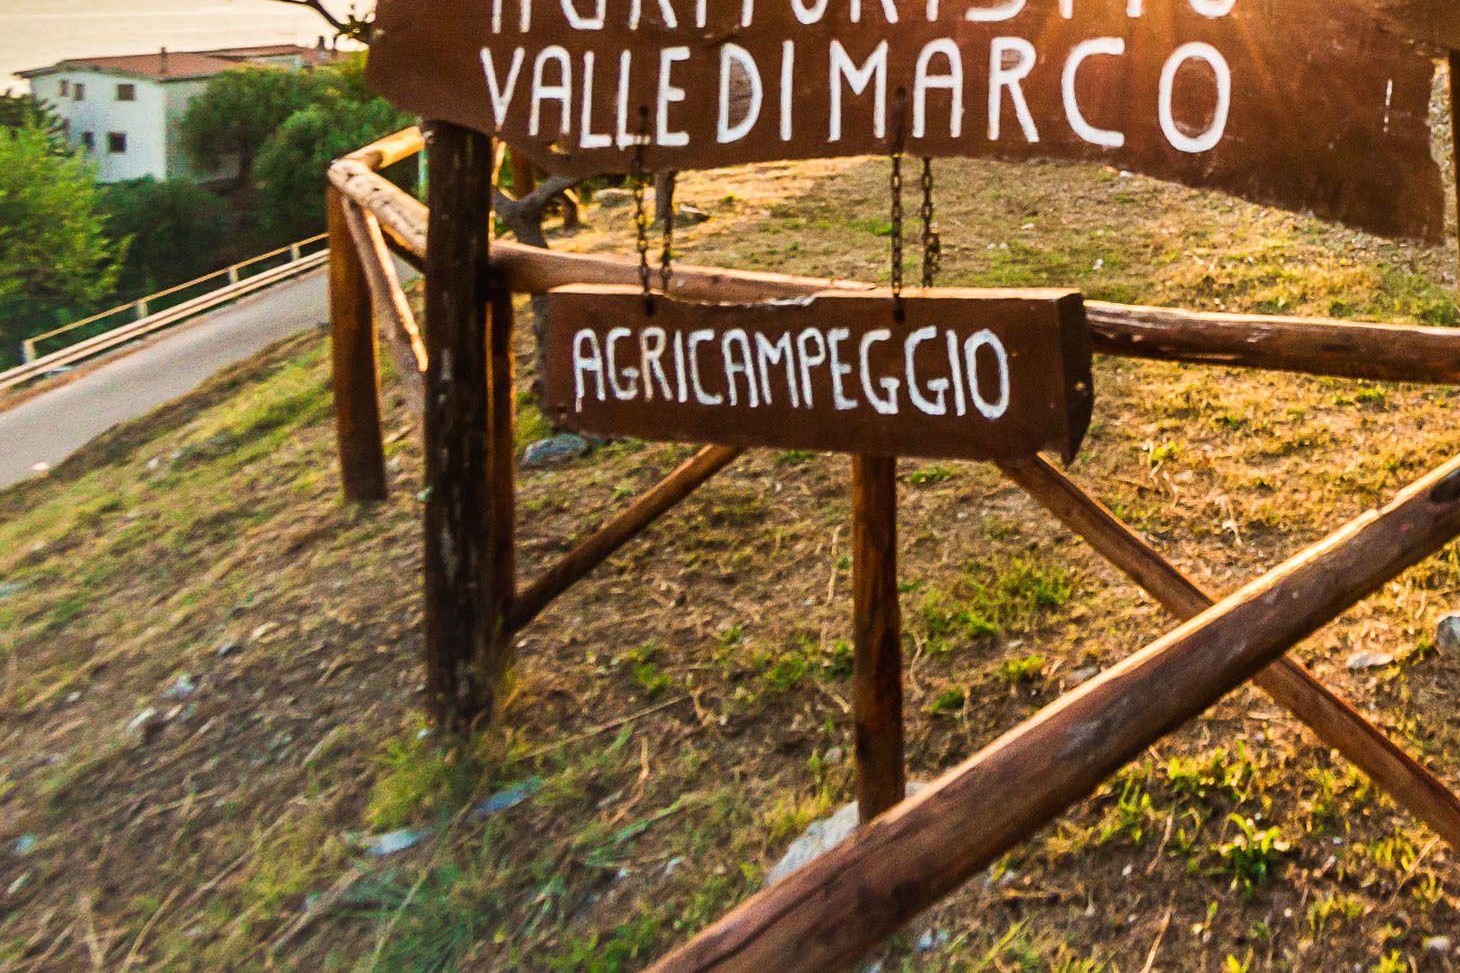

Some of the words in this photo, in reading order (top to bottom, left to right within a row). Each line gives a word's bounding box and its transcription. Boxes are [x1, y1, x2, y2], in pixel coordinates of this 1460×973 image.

[480, 44, 692, 149] VALLE
[716, 39, 795, 145] DI
[827, 36, 1232, 155] MARCO
[572, 325, 1010, 419] AGRICAMPEGGIO
